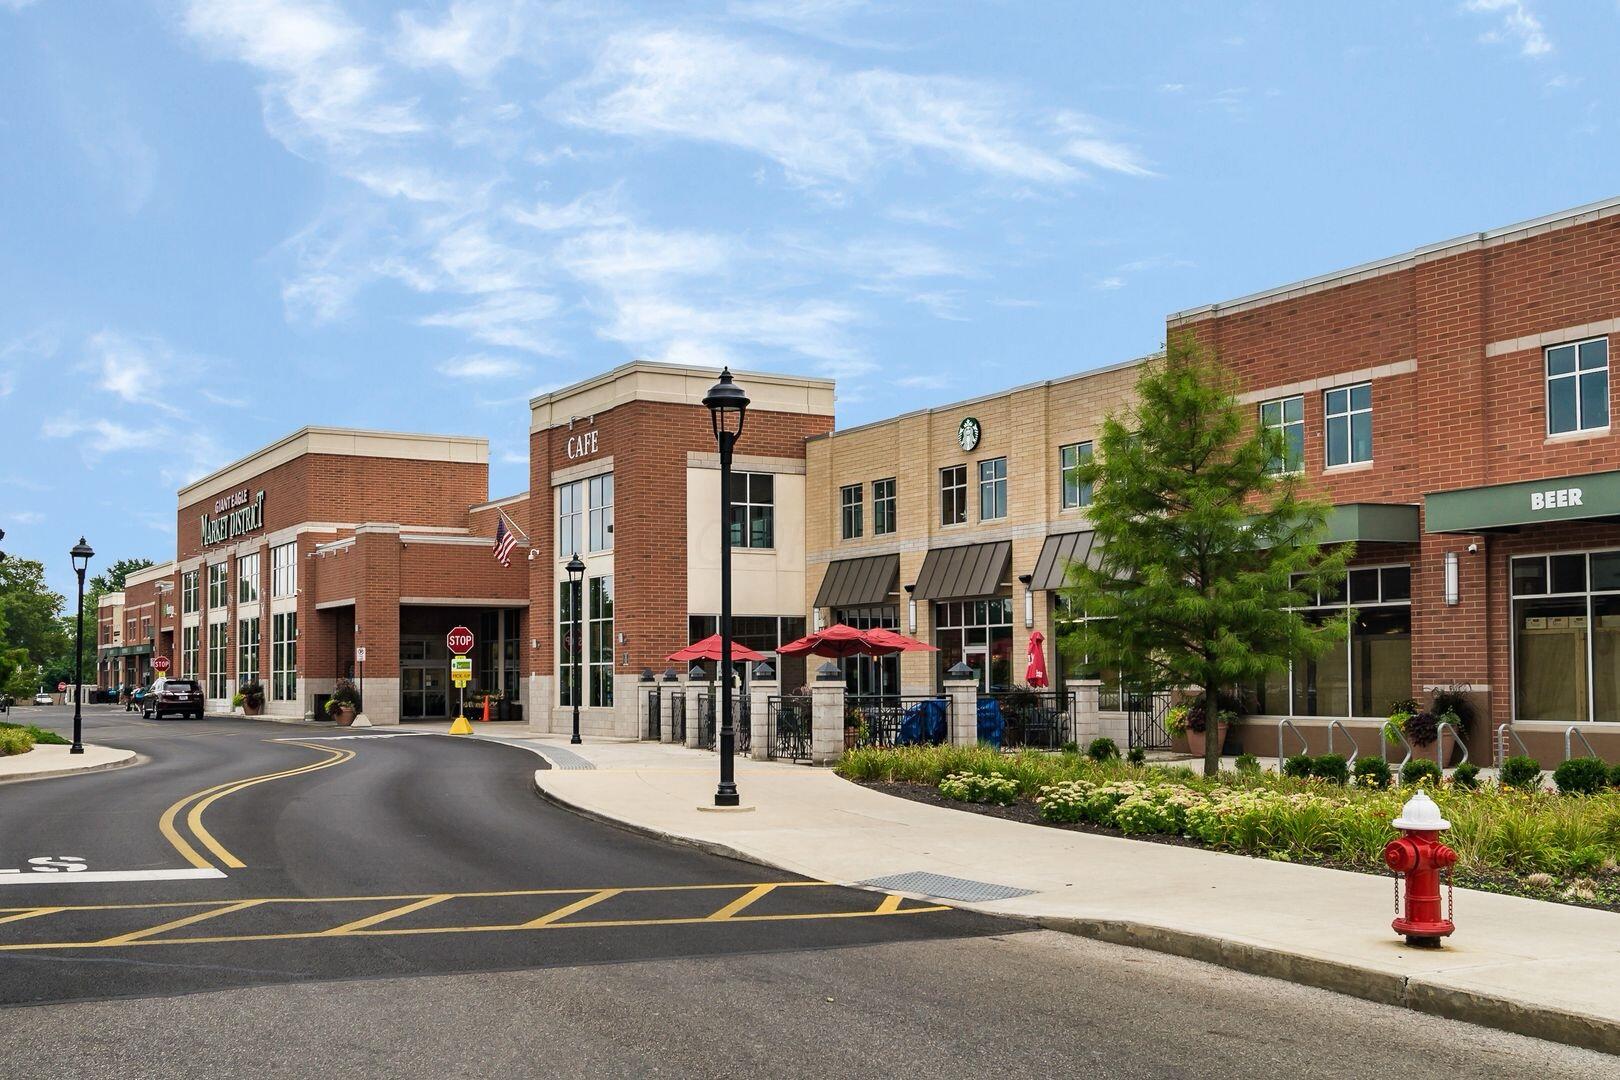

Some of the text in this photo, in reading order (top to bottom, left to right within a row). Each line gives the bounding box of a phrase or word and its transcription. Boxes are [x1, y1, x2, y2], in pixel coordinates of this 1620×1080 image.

[567, 430, 599, 459] CAFE
[215, 489, 248, 514] GIANT EAGLE
[1531, 487, 1583, 510] BEER
[201, 490, 264, 546] MARKET DISTRICT
[449, 635, 472, 646] STOP
